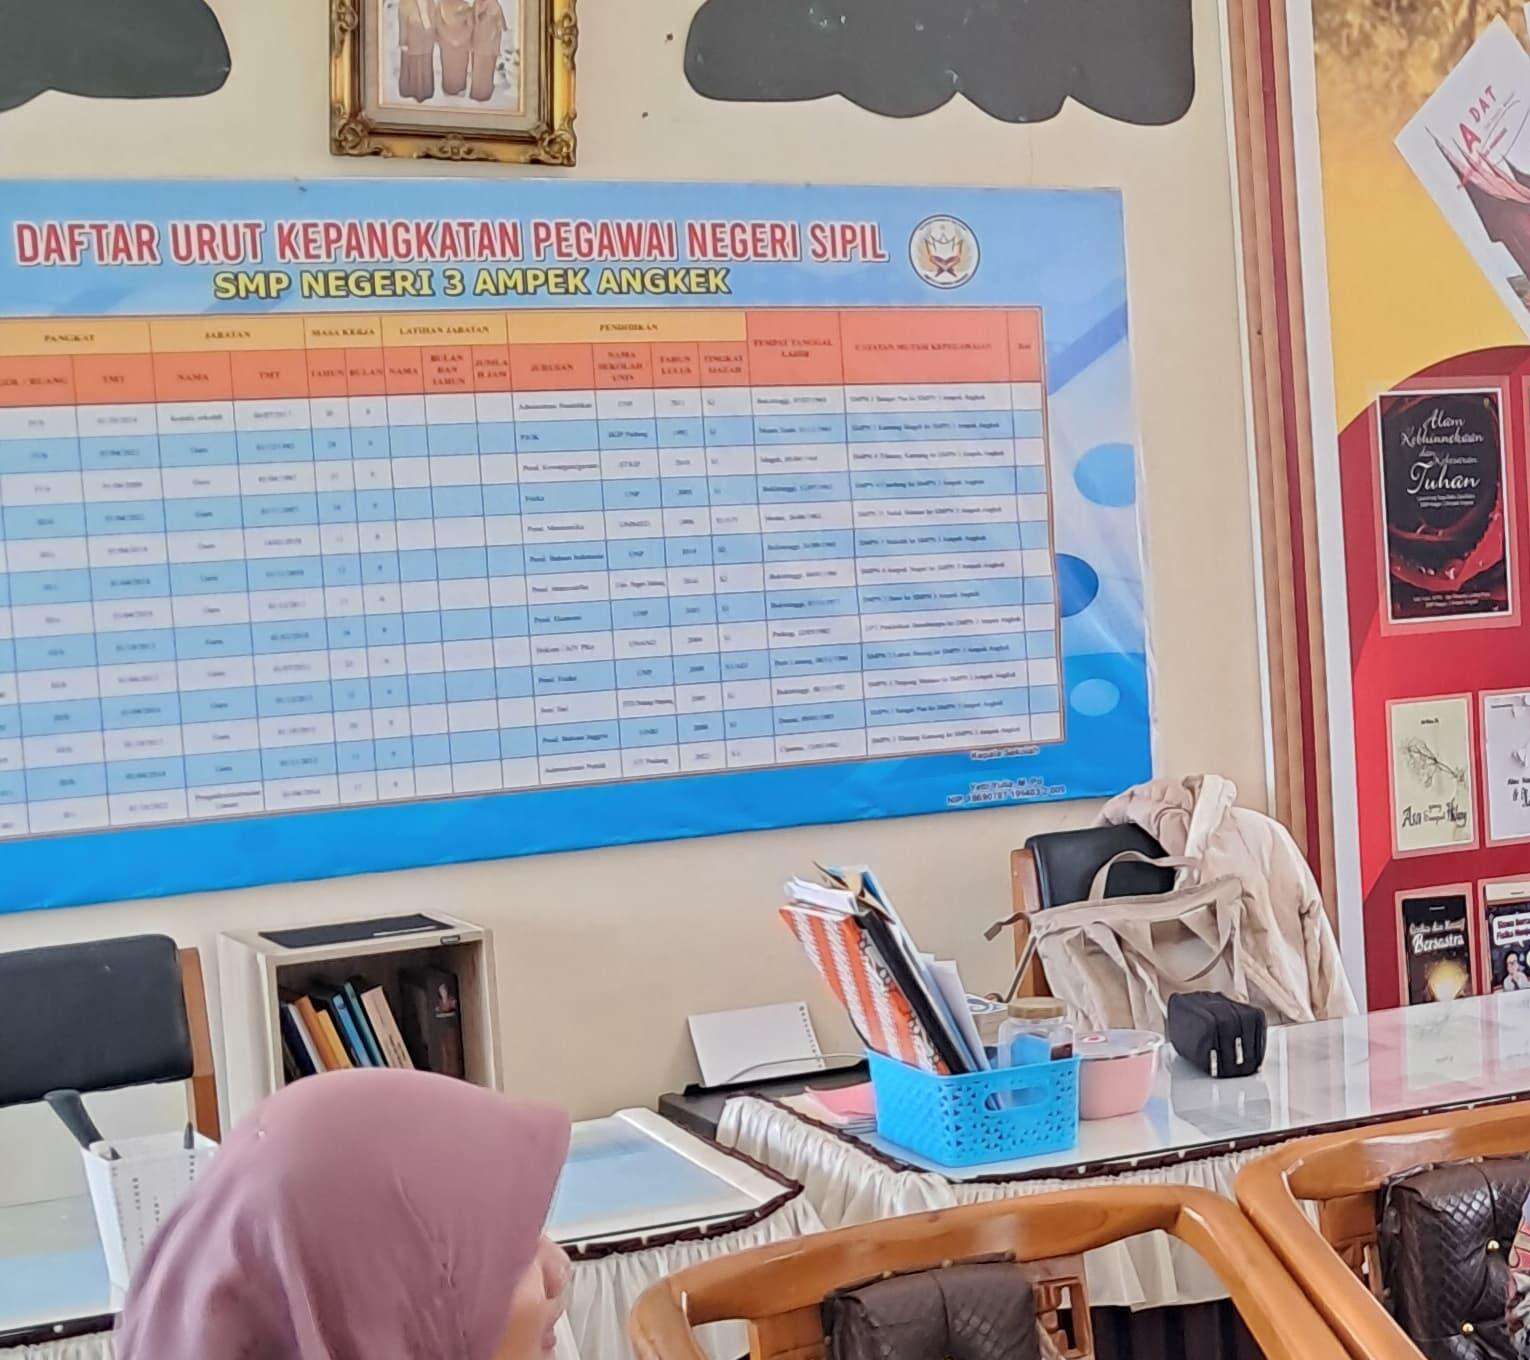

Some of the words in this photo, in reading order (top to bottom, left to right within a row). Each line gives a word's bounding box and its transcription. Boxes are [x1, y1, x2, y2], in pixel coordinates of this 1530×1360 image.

[15, 221, 158, 264] DAFTAR
[171, 221, 264, 263] URUT
[276, 220, 522, 262] KEPANGKATAN
[533, 219, 677, 261] PEGAWAI
[686, 220, 800, 261] NEGERI
[810, 221, 888, 262] SIPIL
[213, 270, 291, 299] SMP
[301, 269, 434, 298] NEGERI
[443, 272, 465, 296] 3
[474, 267, 590, 295] AMPEK
[597, 267, 731, 295] ANGKEK
[1407, 462, 1480, 494] Tuhan
